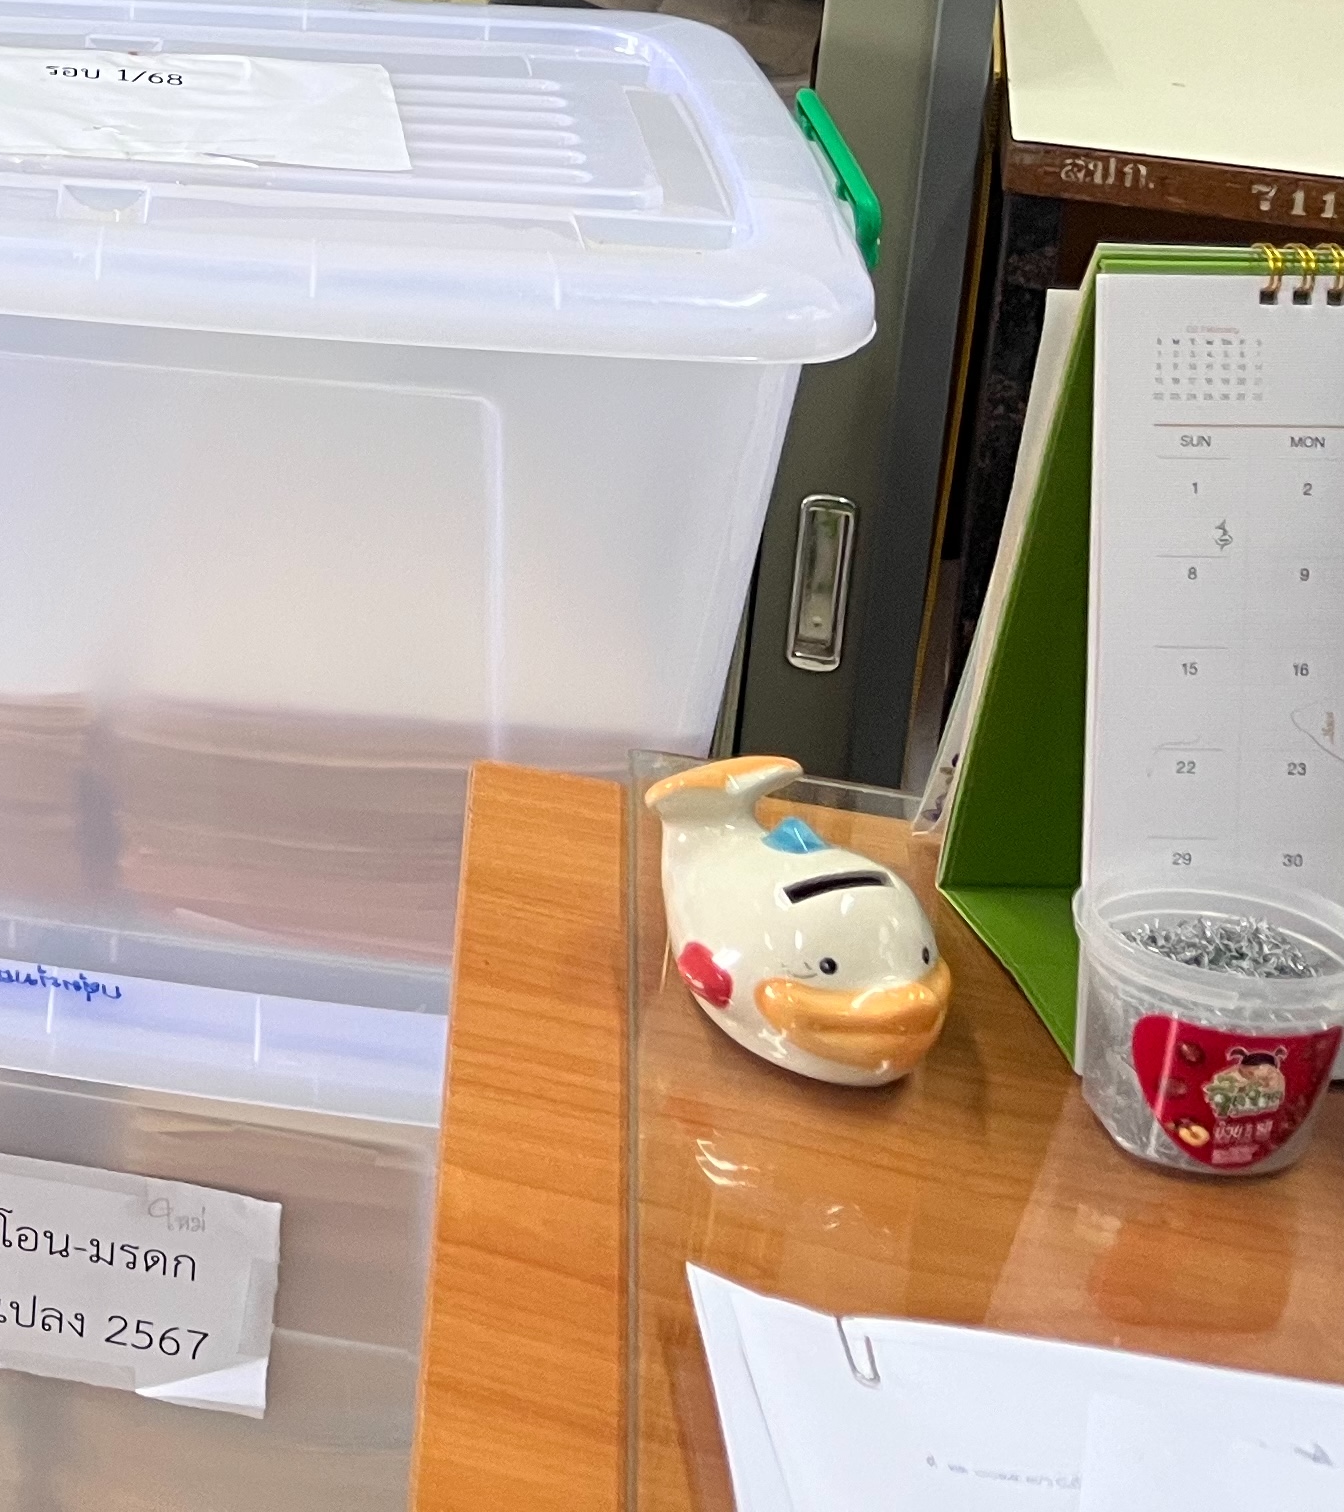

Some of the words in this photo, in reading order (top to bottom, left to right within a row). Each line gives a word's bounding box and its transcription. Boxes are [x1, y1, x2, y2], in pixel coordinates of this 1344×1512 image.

[45, 65, 101, 80] รอบ
[117, 68, 184, 87] 1/68
[1180, 434, 1212, 449] SUN
[1290, 435, 1326, 449] MON
[1192, 482, 1199, 495] 1
[1302, 482, 1312, 496] 2
[1187, 566, 1198, 581] 8
[1300, 566, 1310, 581] 9
[1182, 661, 1199, 676] 15
[1293, 662, 1310, 677] 16
[1176, 760, 1197, 775] 22
[1286, 761, 1307, 777] 23
[1172, 852, 1192, 866] 29
[1282, 853, 1304, 868] 30
[104, 1314, 210, 1361] 2567
